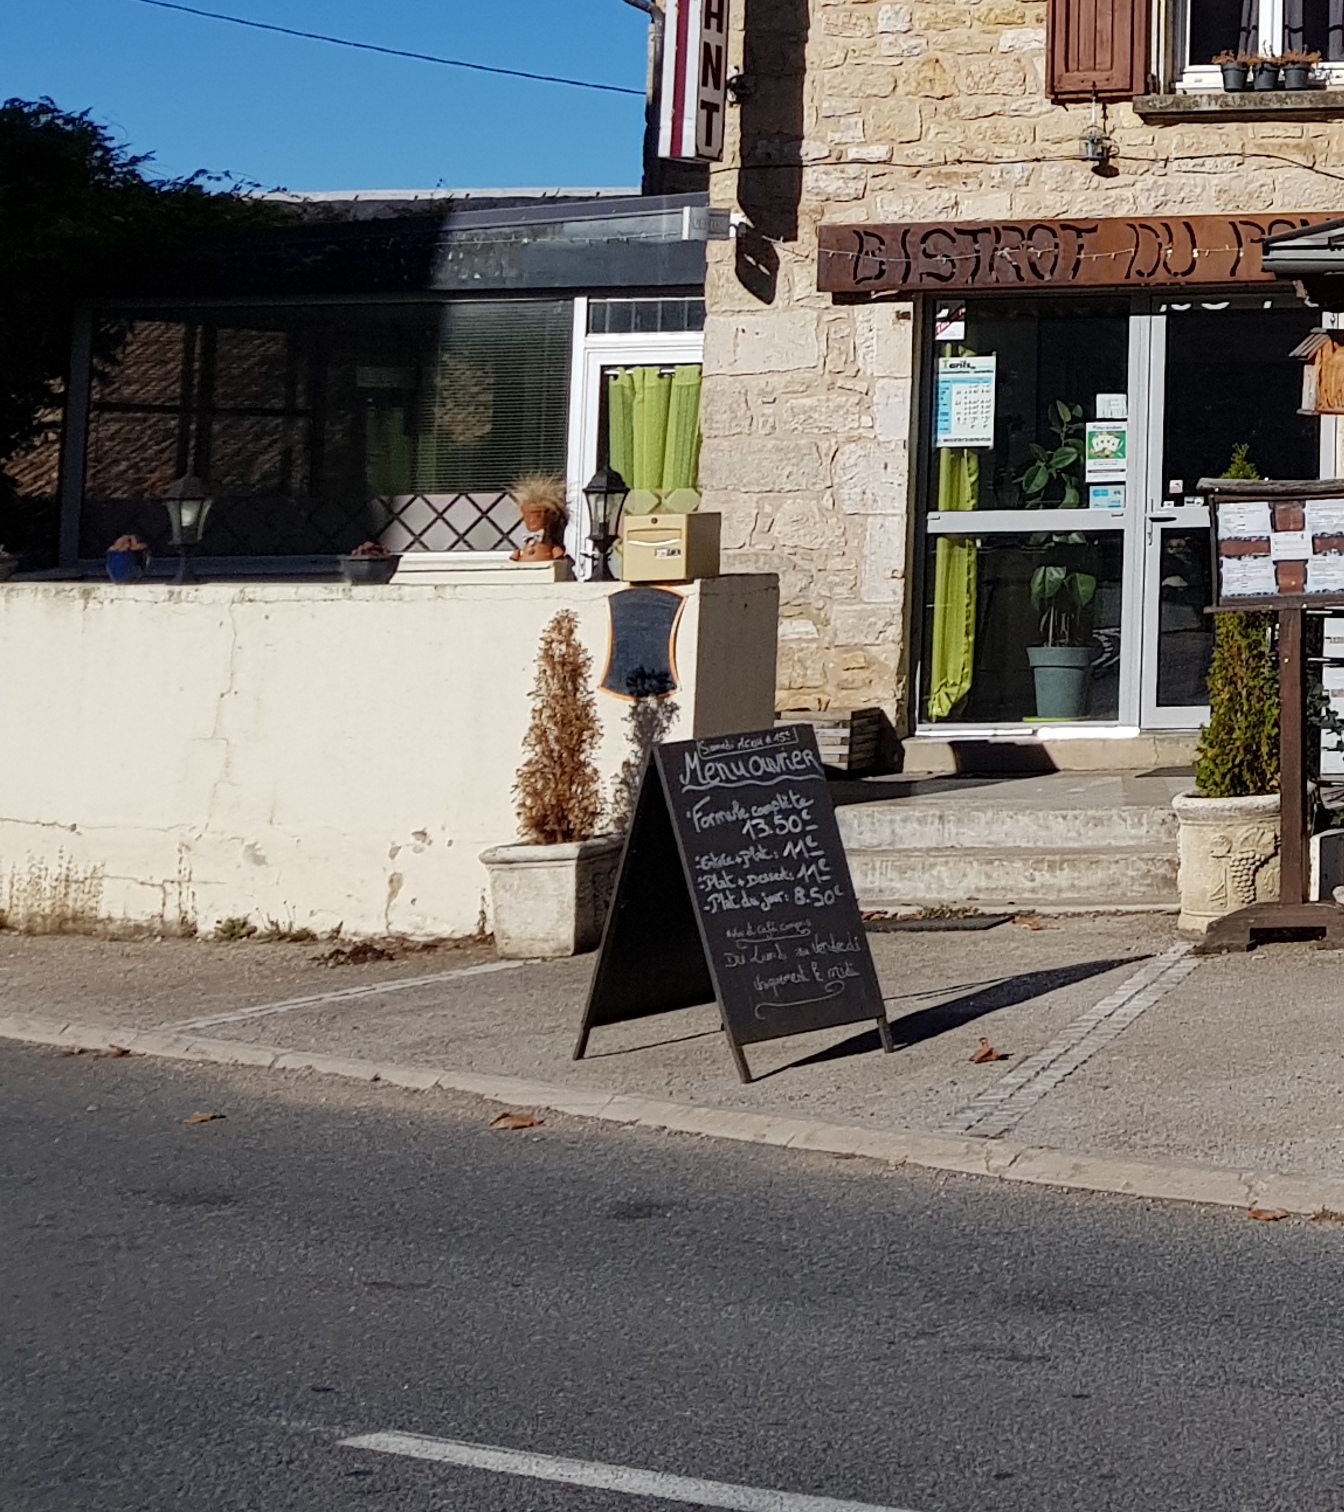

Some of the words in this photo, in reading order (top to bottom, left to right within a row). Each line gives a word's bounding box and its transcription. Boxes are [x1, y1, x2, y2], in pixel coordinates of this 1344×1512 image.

[852, 223, 1099, 285] BISTROT
[1126, 222, 1198, 281] DU
[679, 750, 751, 785] Menu
[741, 889, 760, 908] du
